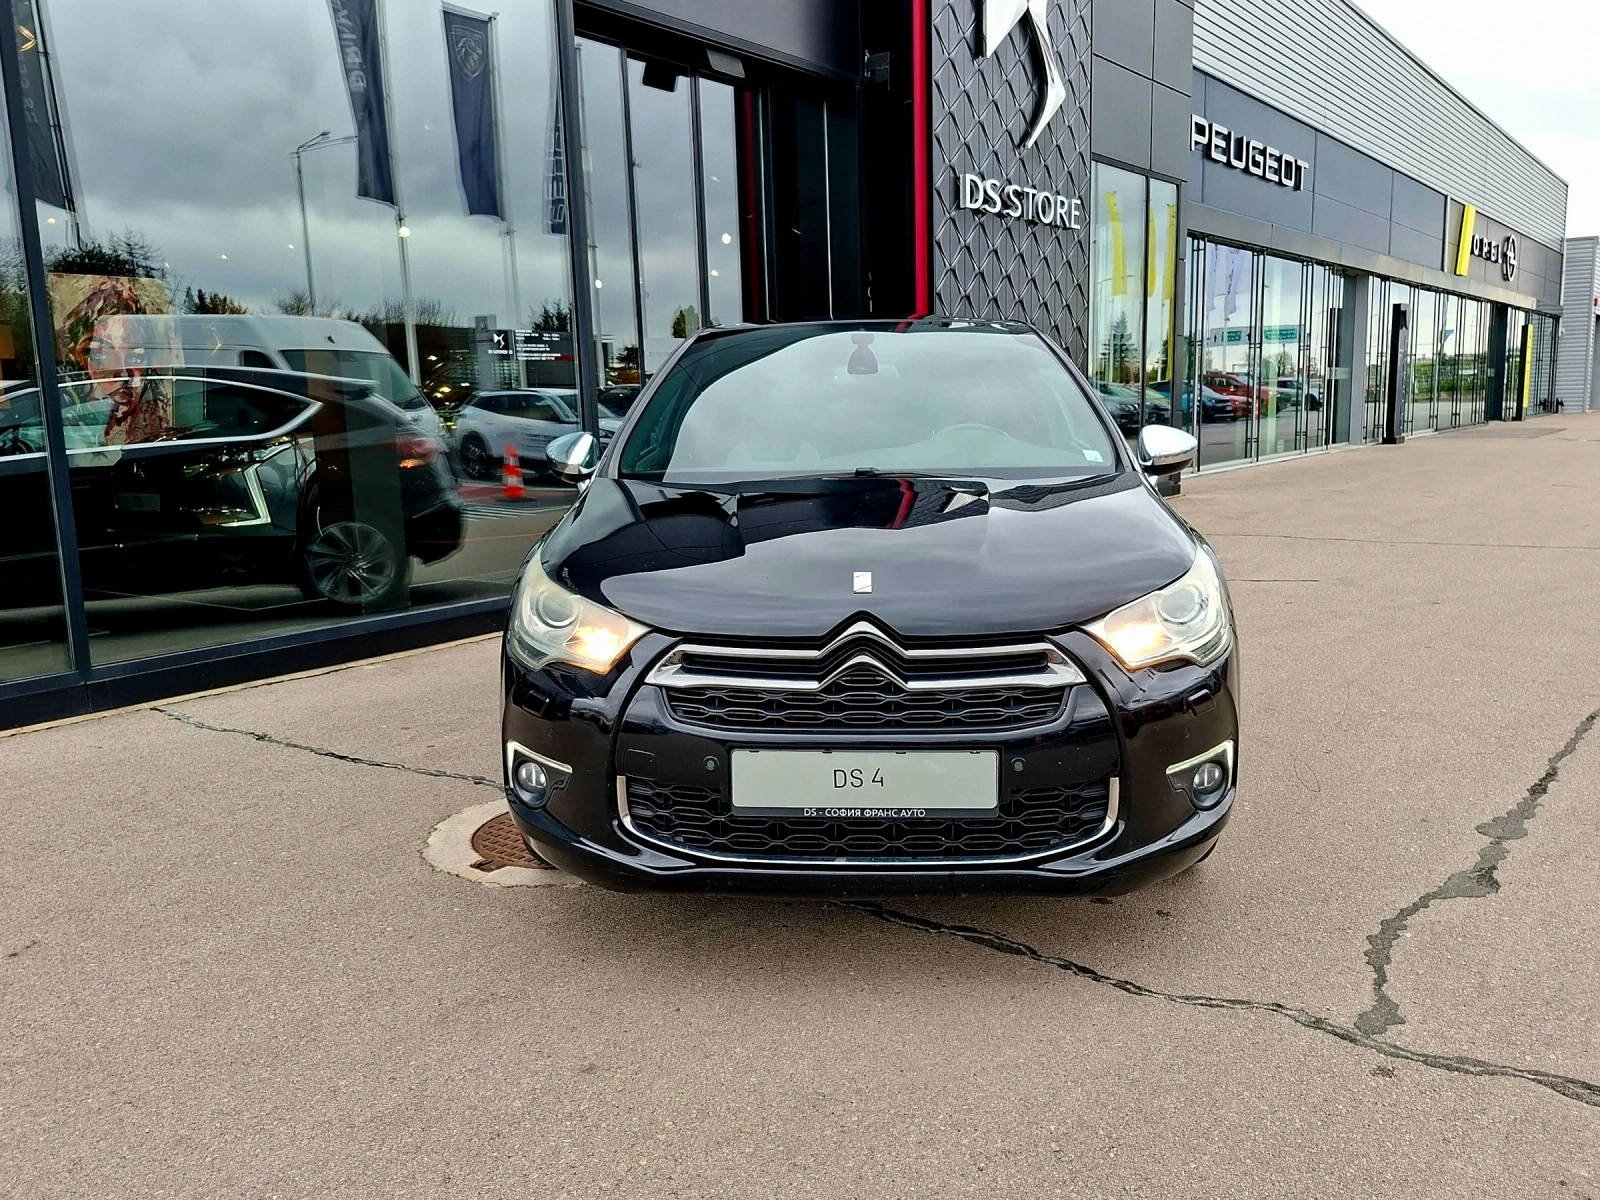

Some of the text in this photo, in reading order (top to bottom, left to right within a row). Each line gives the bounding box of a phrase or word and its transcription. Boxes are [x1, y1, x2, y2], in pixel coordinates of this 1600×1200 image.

[1190, 113, 1309, 192] PEUGEOT
[960, 174, 1081, 229] DS STORE
[833, 768, 884, 788] DS 4
[804, 809, 817, 817] DS
[825, 809, 861, 818] СОФИЯ
[863, 809, 898, 818] ФРАНС
[900, 809, 926, 818] АУТО
